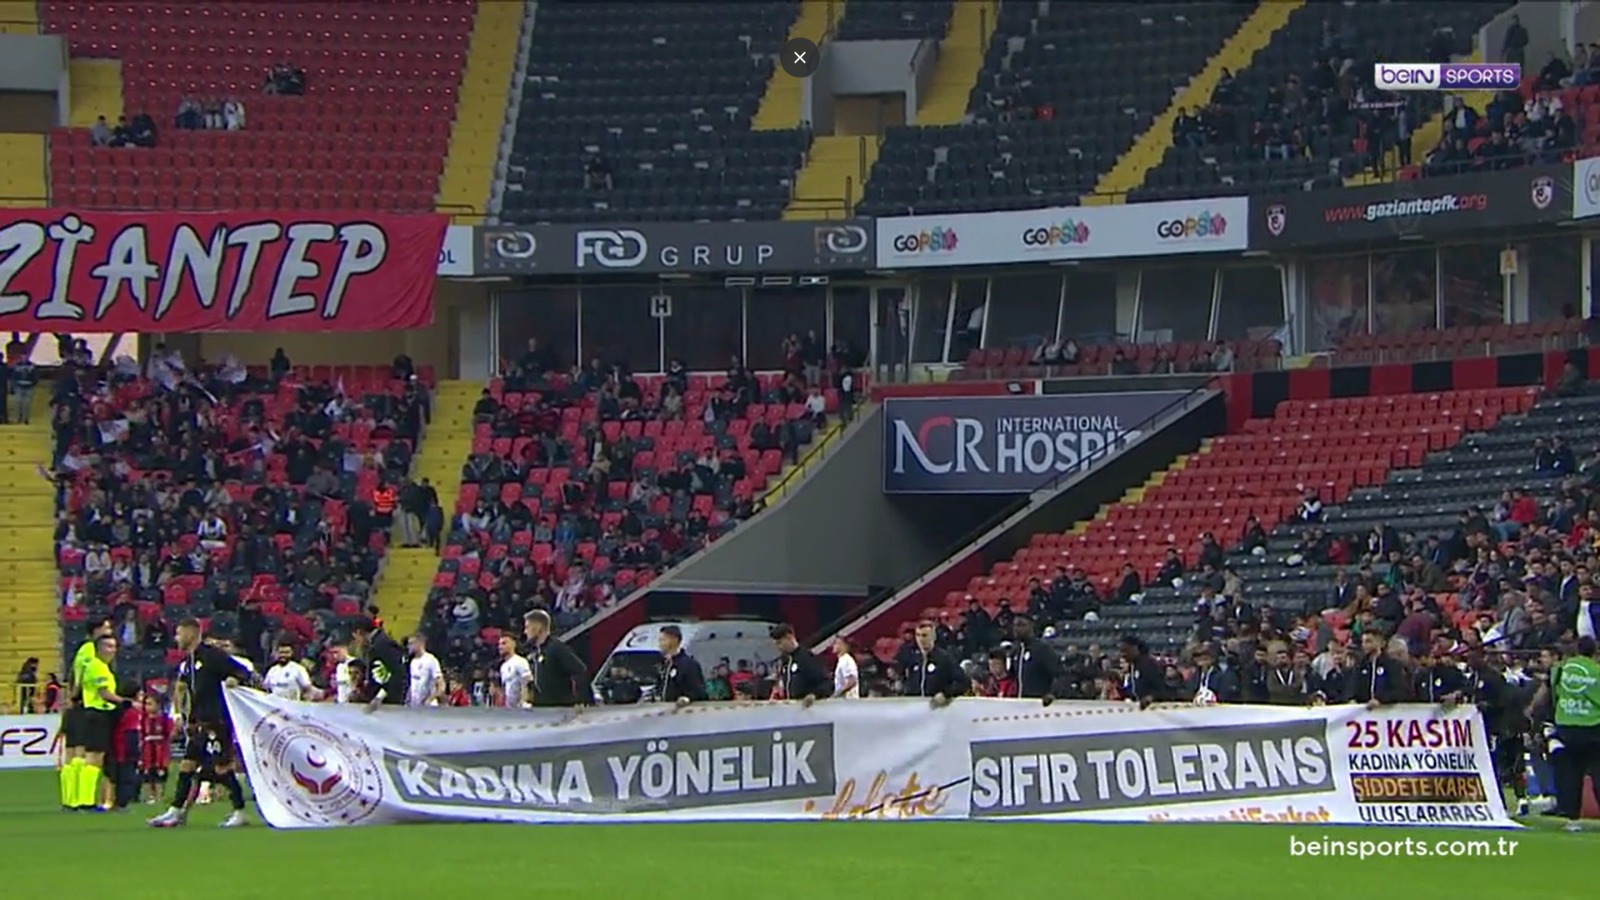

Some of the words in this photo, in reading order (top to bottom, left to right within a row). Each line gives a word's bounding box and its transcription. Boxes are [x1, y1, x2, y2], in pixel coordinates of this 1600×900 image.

[660, 245, 774, 267] GRUP
[655, 298, 668, 314] H
[997, 415, 1121, 432] INTERNATIONAL
[893, 416, 991, 474] NCR
[1346, 720, 1380, 748] 25
[1386, 719, 1474, 748] KASIM
[397, 759, 593, 804] KADINA
[607, 731, 816, 801] YÖNELİK
[972, 754, 1080, 807] SIFIR
[1087, 736, 1328, 800] TOLERANS
[1349, 753, 1412, 771] KADINA
[1358, 804, 1494, 822] ULUSLARARASI
